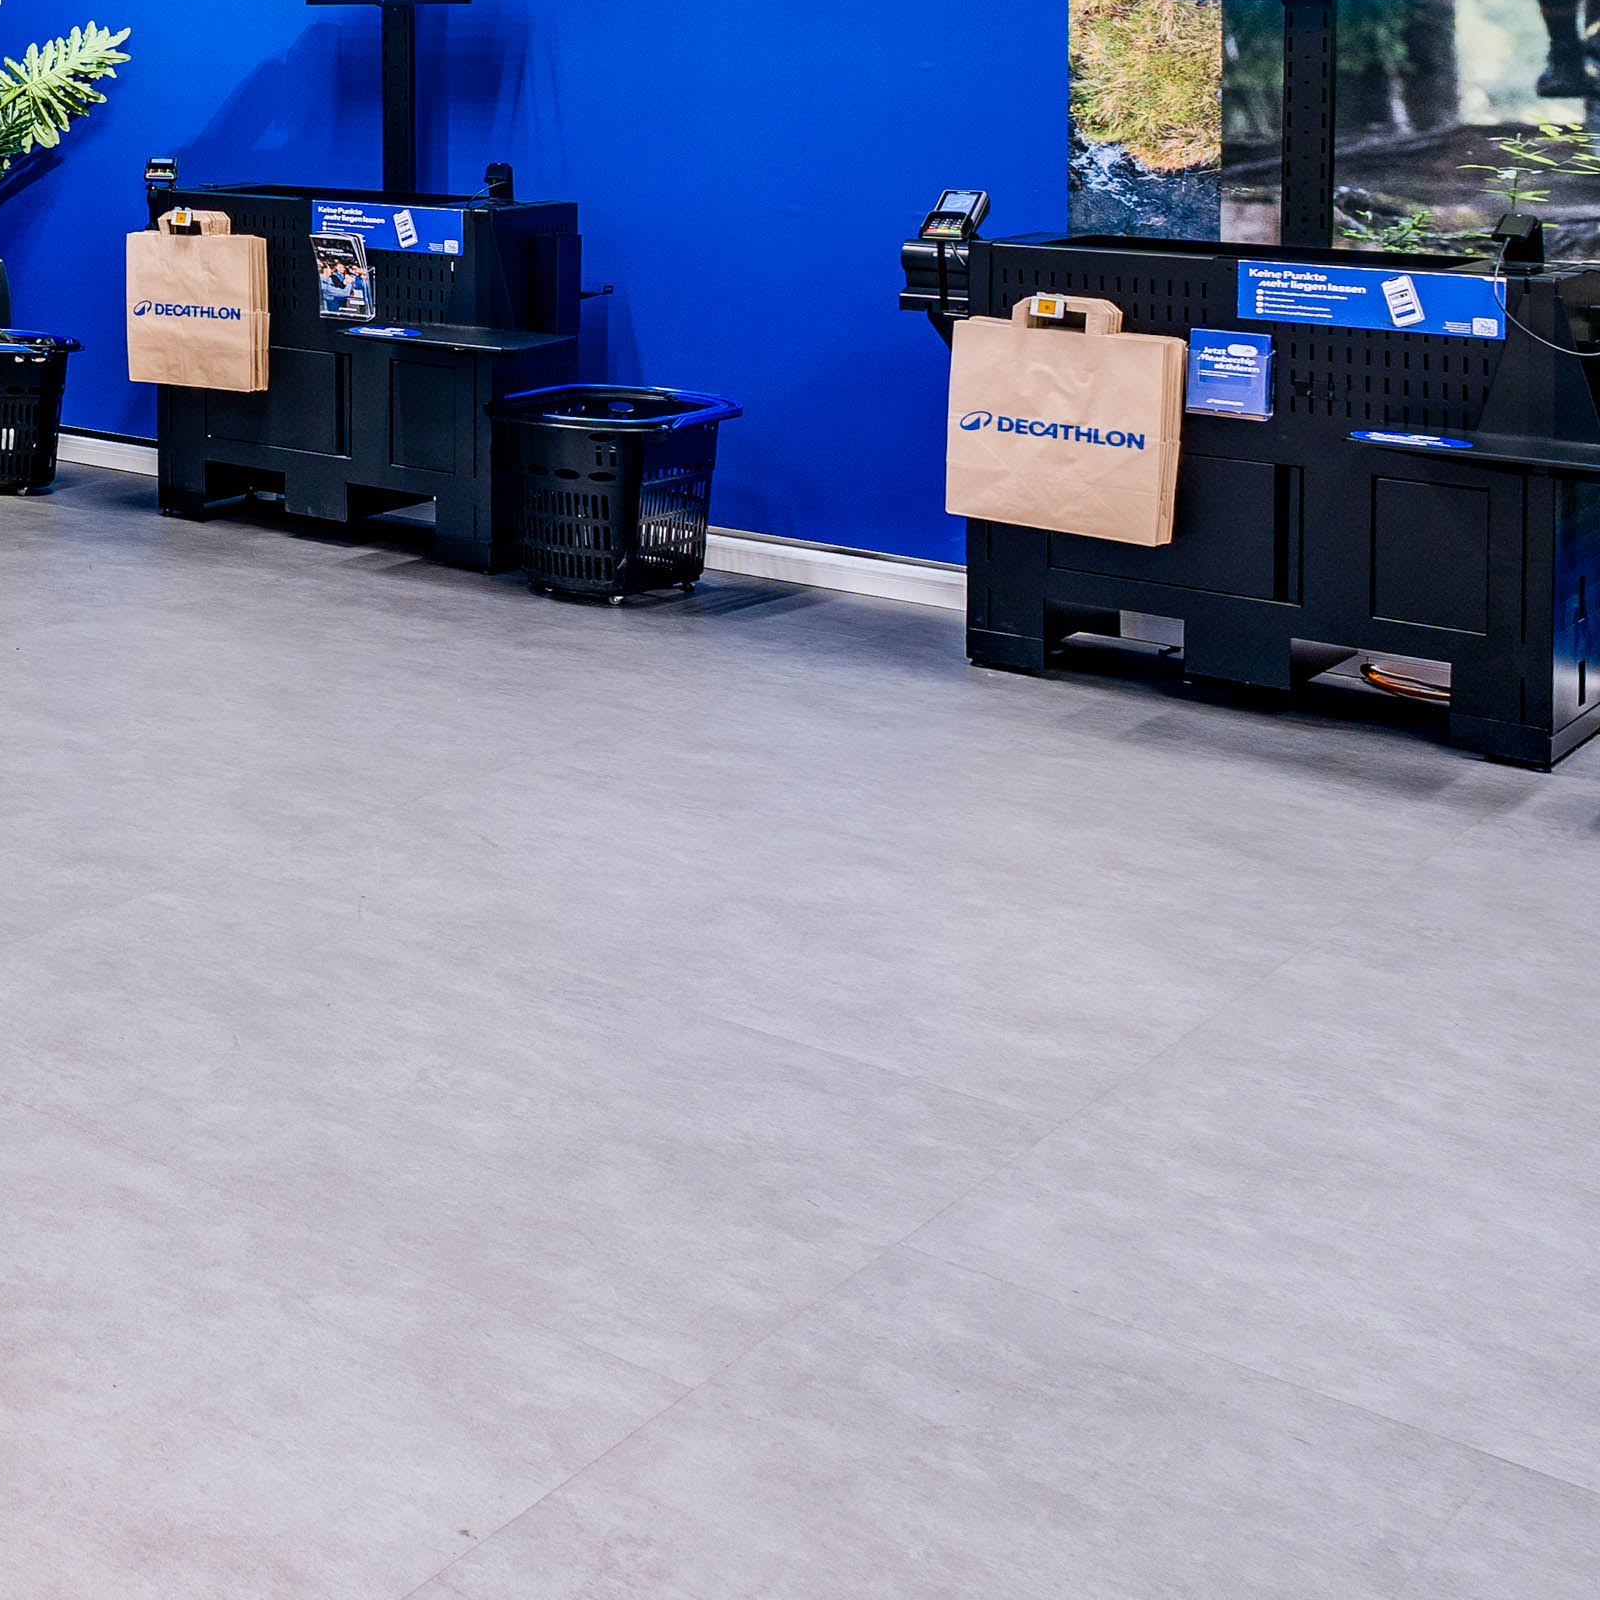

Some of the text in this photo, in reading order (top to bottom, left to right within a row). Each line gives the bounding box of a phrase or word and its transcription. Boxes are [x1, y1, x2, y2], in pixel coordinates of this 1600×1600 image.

[1249, 268, 1327, 282] Keine Punkte
[1290, 281, 1327, 292] liegen
[1327, 283, 1367, 294] lassen
[154, 303, 241, 320] DECATHLON
[997, 416, 1145, 450] DECATHLON
